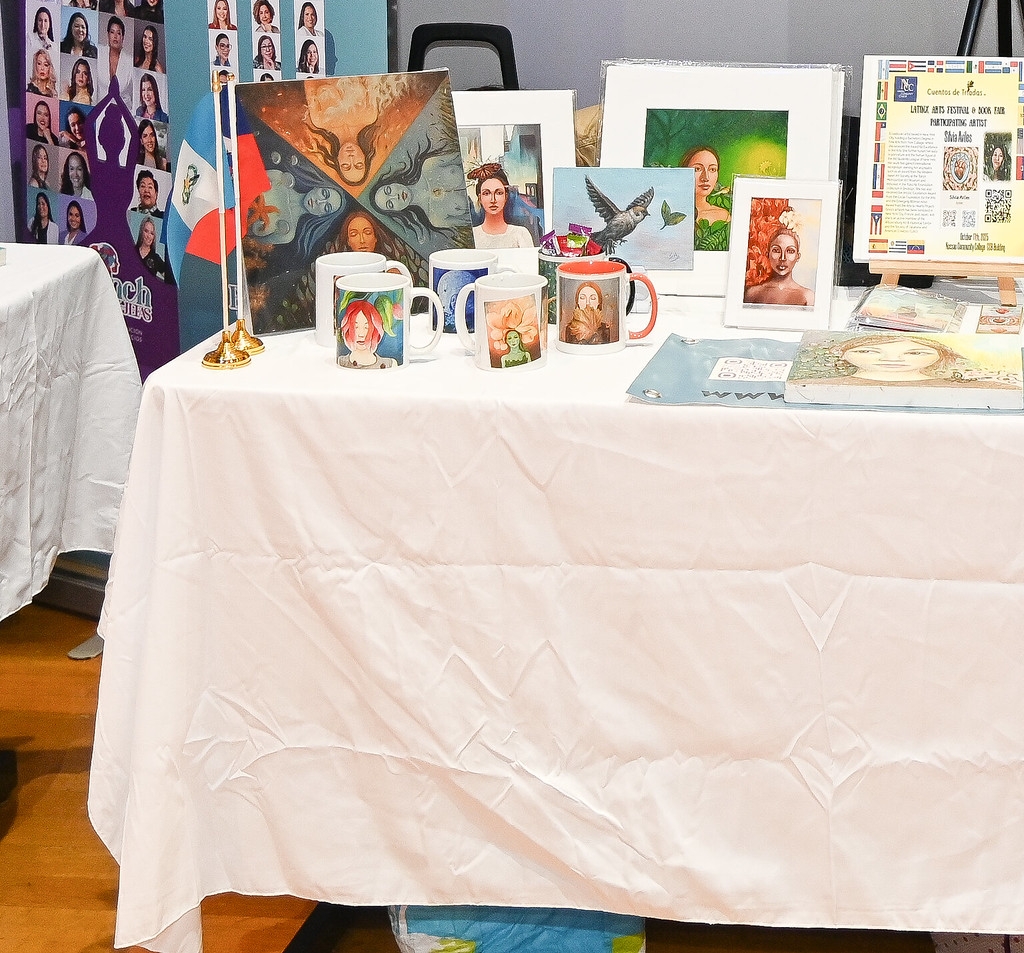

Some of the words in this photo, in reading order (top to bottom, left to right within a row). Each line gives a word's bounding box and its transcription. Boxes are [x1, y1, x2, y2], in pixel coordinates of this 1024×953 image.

[927, 88, 951, 96] Cuentos
[953, 88, 961, 96] de
[931, 105, 945, 114] ARTS
[969, 118, 988, 127] ARTIST
[943, 130, 958, 143] Silvia
